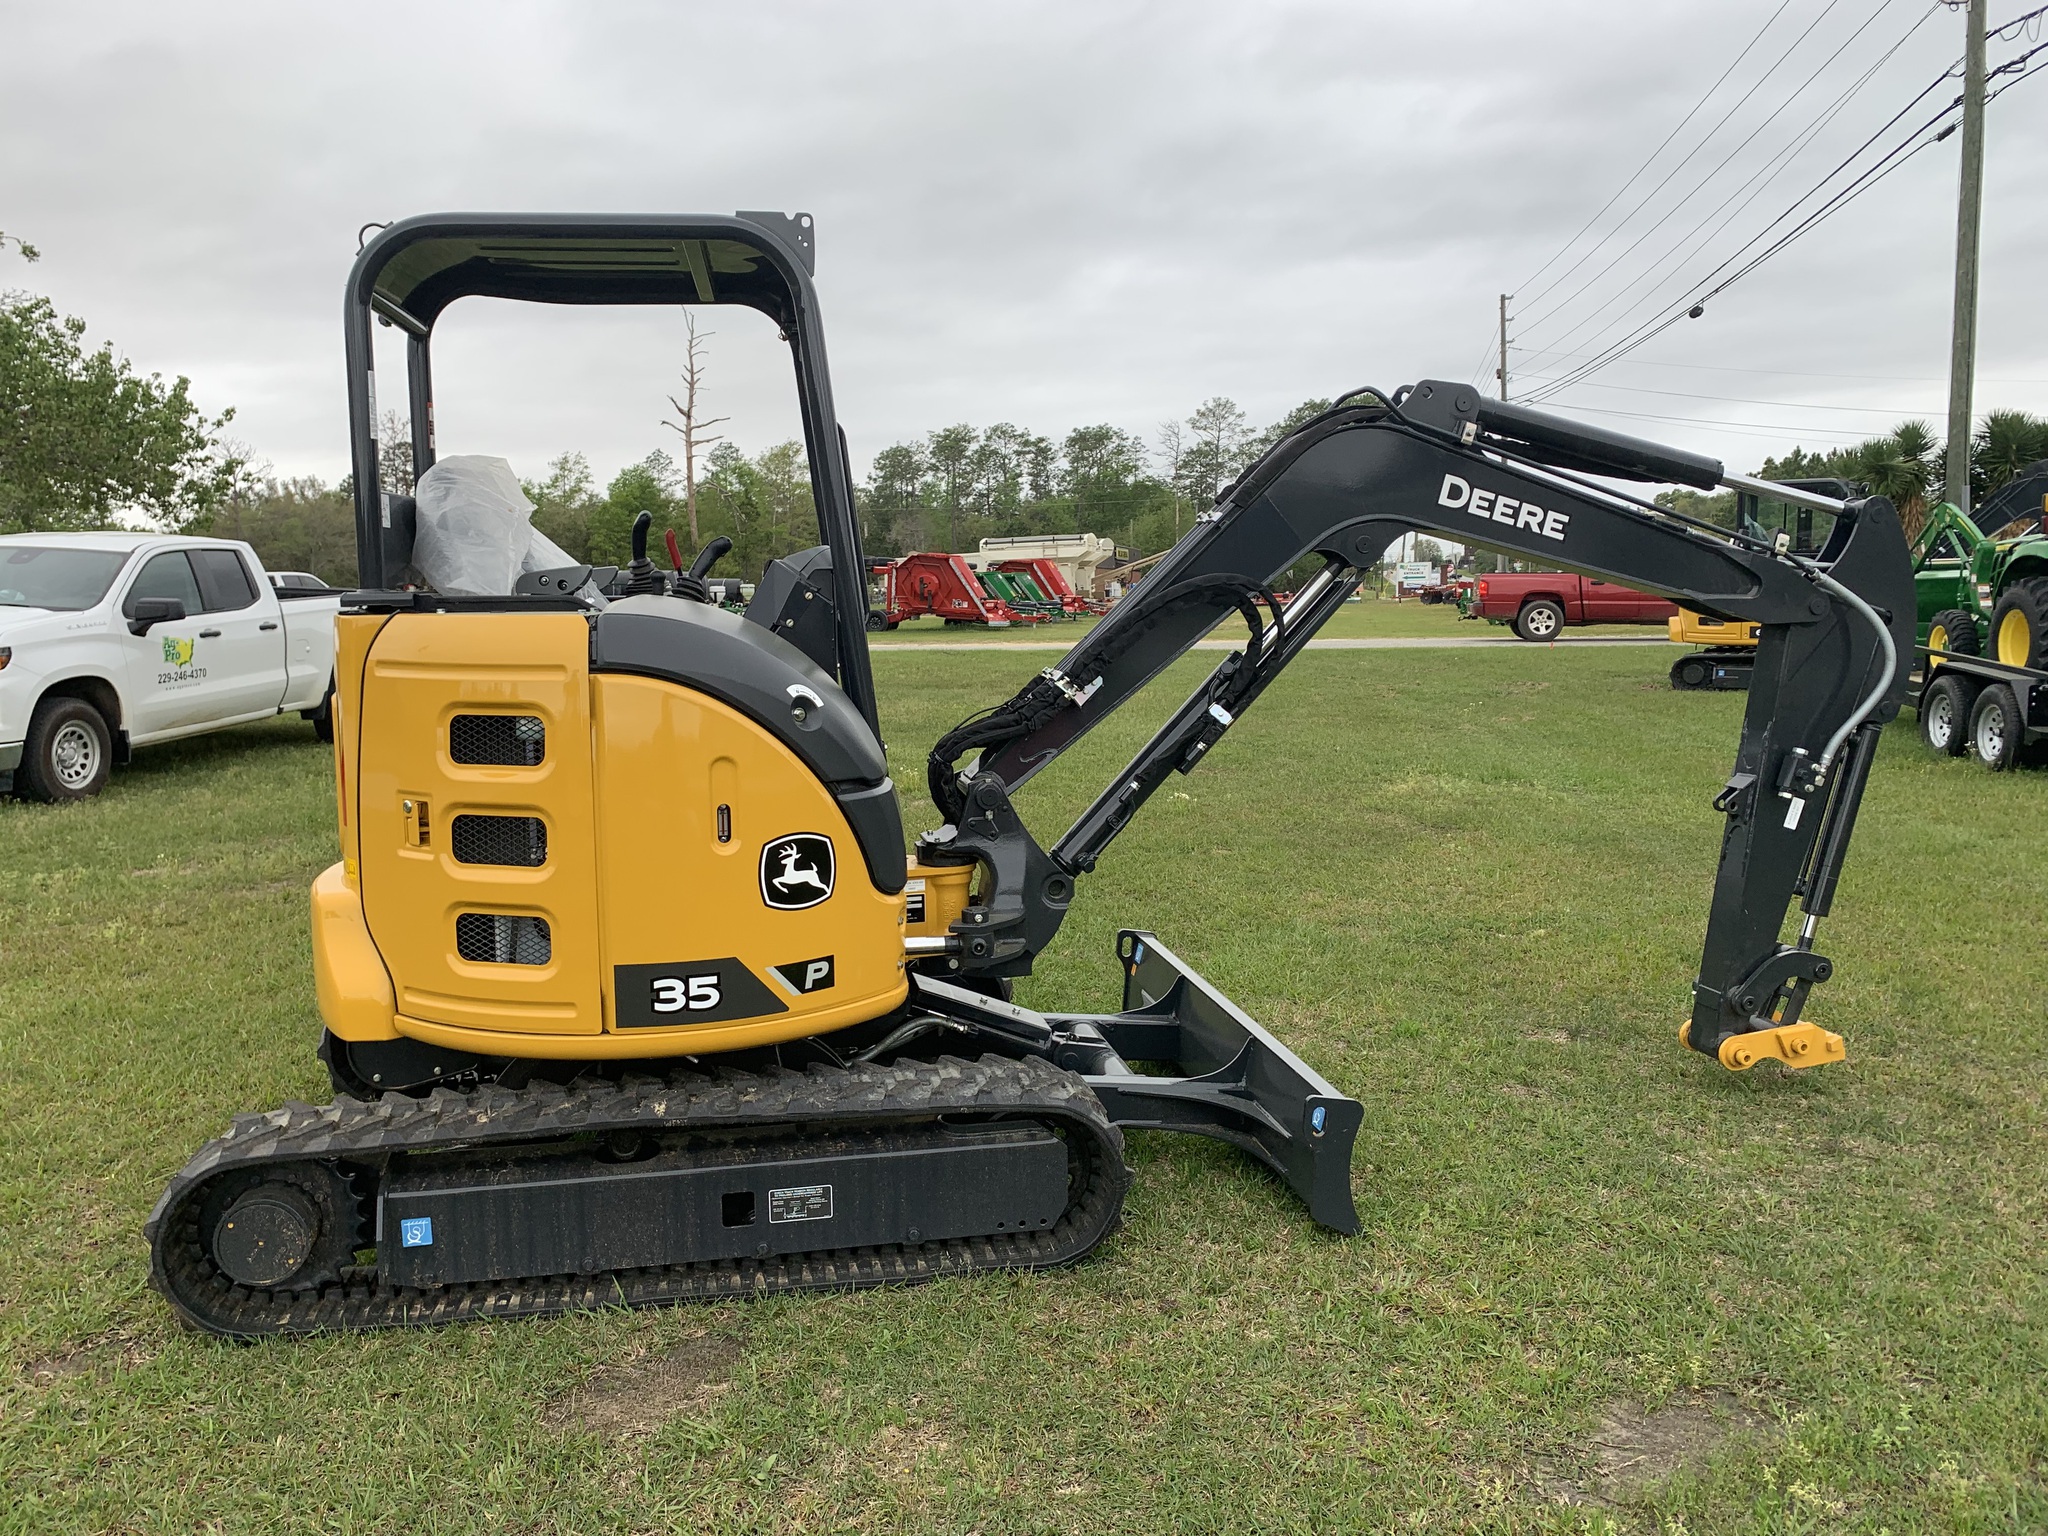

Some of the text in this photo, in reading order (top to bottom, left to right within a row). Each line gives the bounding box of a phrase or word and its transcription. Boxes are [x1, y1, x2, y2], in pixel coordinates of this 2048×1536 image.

[1438, 473, 1570, 541] DEERE
[165, 650, 181, 661] Pro
[158, 668, 207, 684] 229-246-4370
[804, 960, 830, 990] P
[651, 973, 722, 1013] 35
